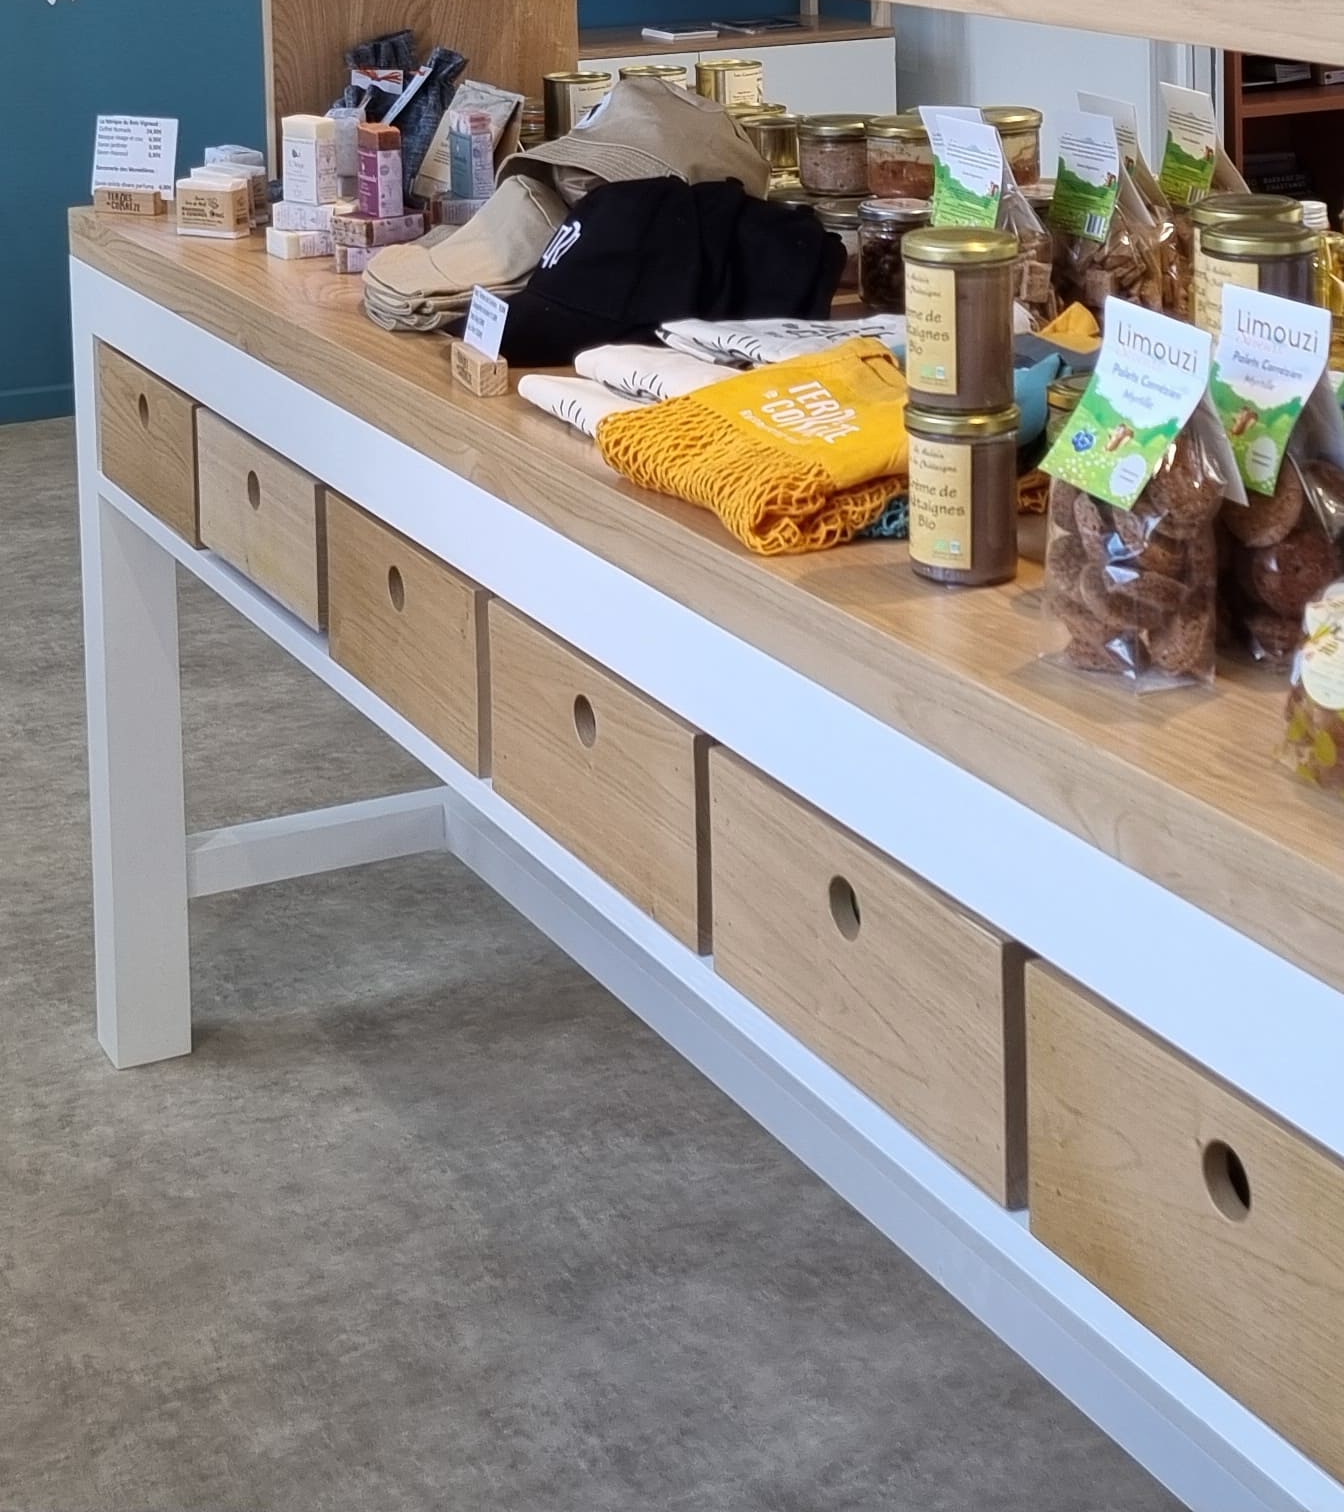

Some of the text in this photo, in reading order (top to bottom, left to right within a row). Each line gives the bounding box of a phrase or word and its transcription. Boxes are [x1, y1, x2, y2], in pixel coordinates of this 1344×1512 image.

[925, 310, 942, 323] de
[1237, 309, 1319, 354] Limouzi
[1117, 320, 1198, 374] Limouzi
[939, 485, 957, 498] de
[918, 515, 937, 530] Bio
